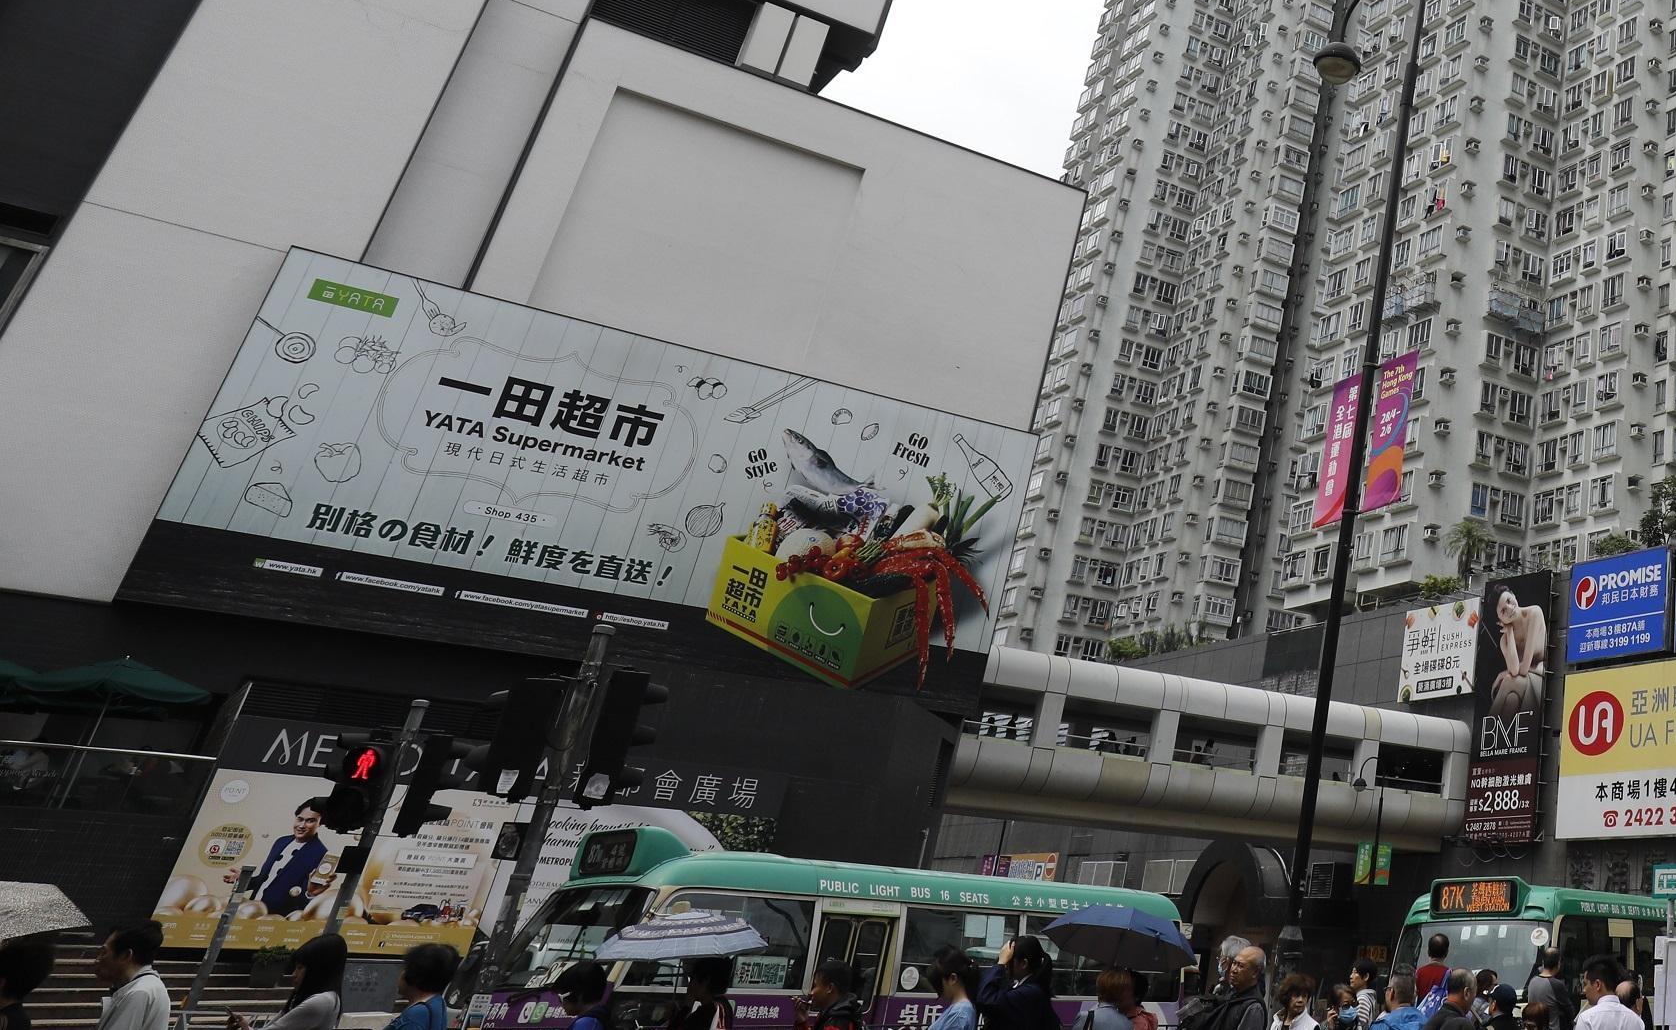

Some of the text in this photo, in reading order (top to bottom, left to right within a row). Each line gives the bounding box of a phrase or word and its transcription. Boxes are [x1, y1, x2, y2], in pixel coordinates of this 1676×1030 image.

[338, 289, 385, 312] YATA
[1382, 371, 1413, 389] Hong Kong
[1383, 364, 1405, 379] The 7th
[1381, 386, 1400, 400] Games
[438, 376, 664, 448] 一田超市
[1341, 385, 1359, 440] 第七屆
[1380, 423, 1392, 437] 2/6
[424, 410, 645, 472] YATA Supermarket
[908, 432, 928, 450] GO
[1324, 405, 1346, 497] 全港運動會
[444, 441, 610, 486] 現代日式生活超市
[748, 448, 768, 464] GO
[892, 442, 931, 468] Fresh
[745, 460, 778, 480] Style
[485, 506, 537, 523] Shop 435
[268, 563, 317, 575] www.yata.hk
[733, 565, 768, 589] 一田
[1599, 564, 1662, 591] PROMISE
[345, 573, 441, 594] www.facebook.com/yatahk
[725, 578, 763, 608] 超市
[1601, 584, 1659, 606] 邦民日本財務
[724, 597, 757, 618] YATA
[1406, 627, 1437, 657] 爭鮮
[1441, 639, 1472, 651] EXPRESS
[1442, 632, 1463, 643] SUSHI
[1579, 633, 1651, 653] 迎新專線 3199 1199
[1413, 655, 1461, 675] 全場碟碟8元
[1629, 723, 1657, 748] UA
[1480, 750, 1493, 758] BELLA
[1509, 746, 1528, 754] FRANCE
[1624, 808, 1664, 826] 2422
[820, 879, 989, 905] PUBLIC LIGHT BUS 16 SEATS
[1442, 886, 1466, 910] 87K
[1466, 902, 1510, 912] WEST STATION
[1580, 901, 1596, 913] PUBLIC
[1611, 904, 1620, 914] BUS
[1627, 904, 1640, 916] SEATS
[736, 1005, 780, 1019] 聯絡熱線
